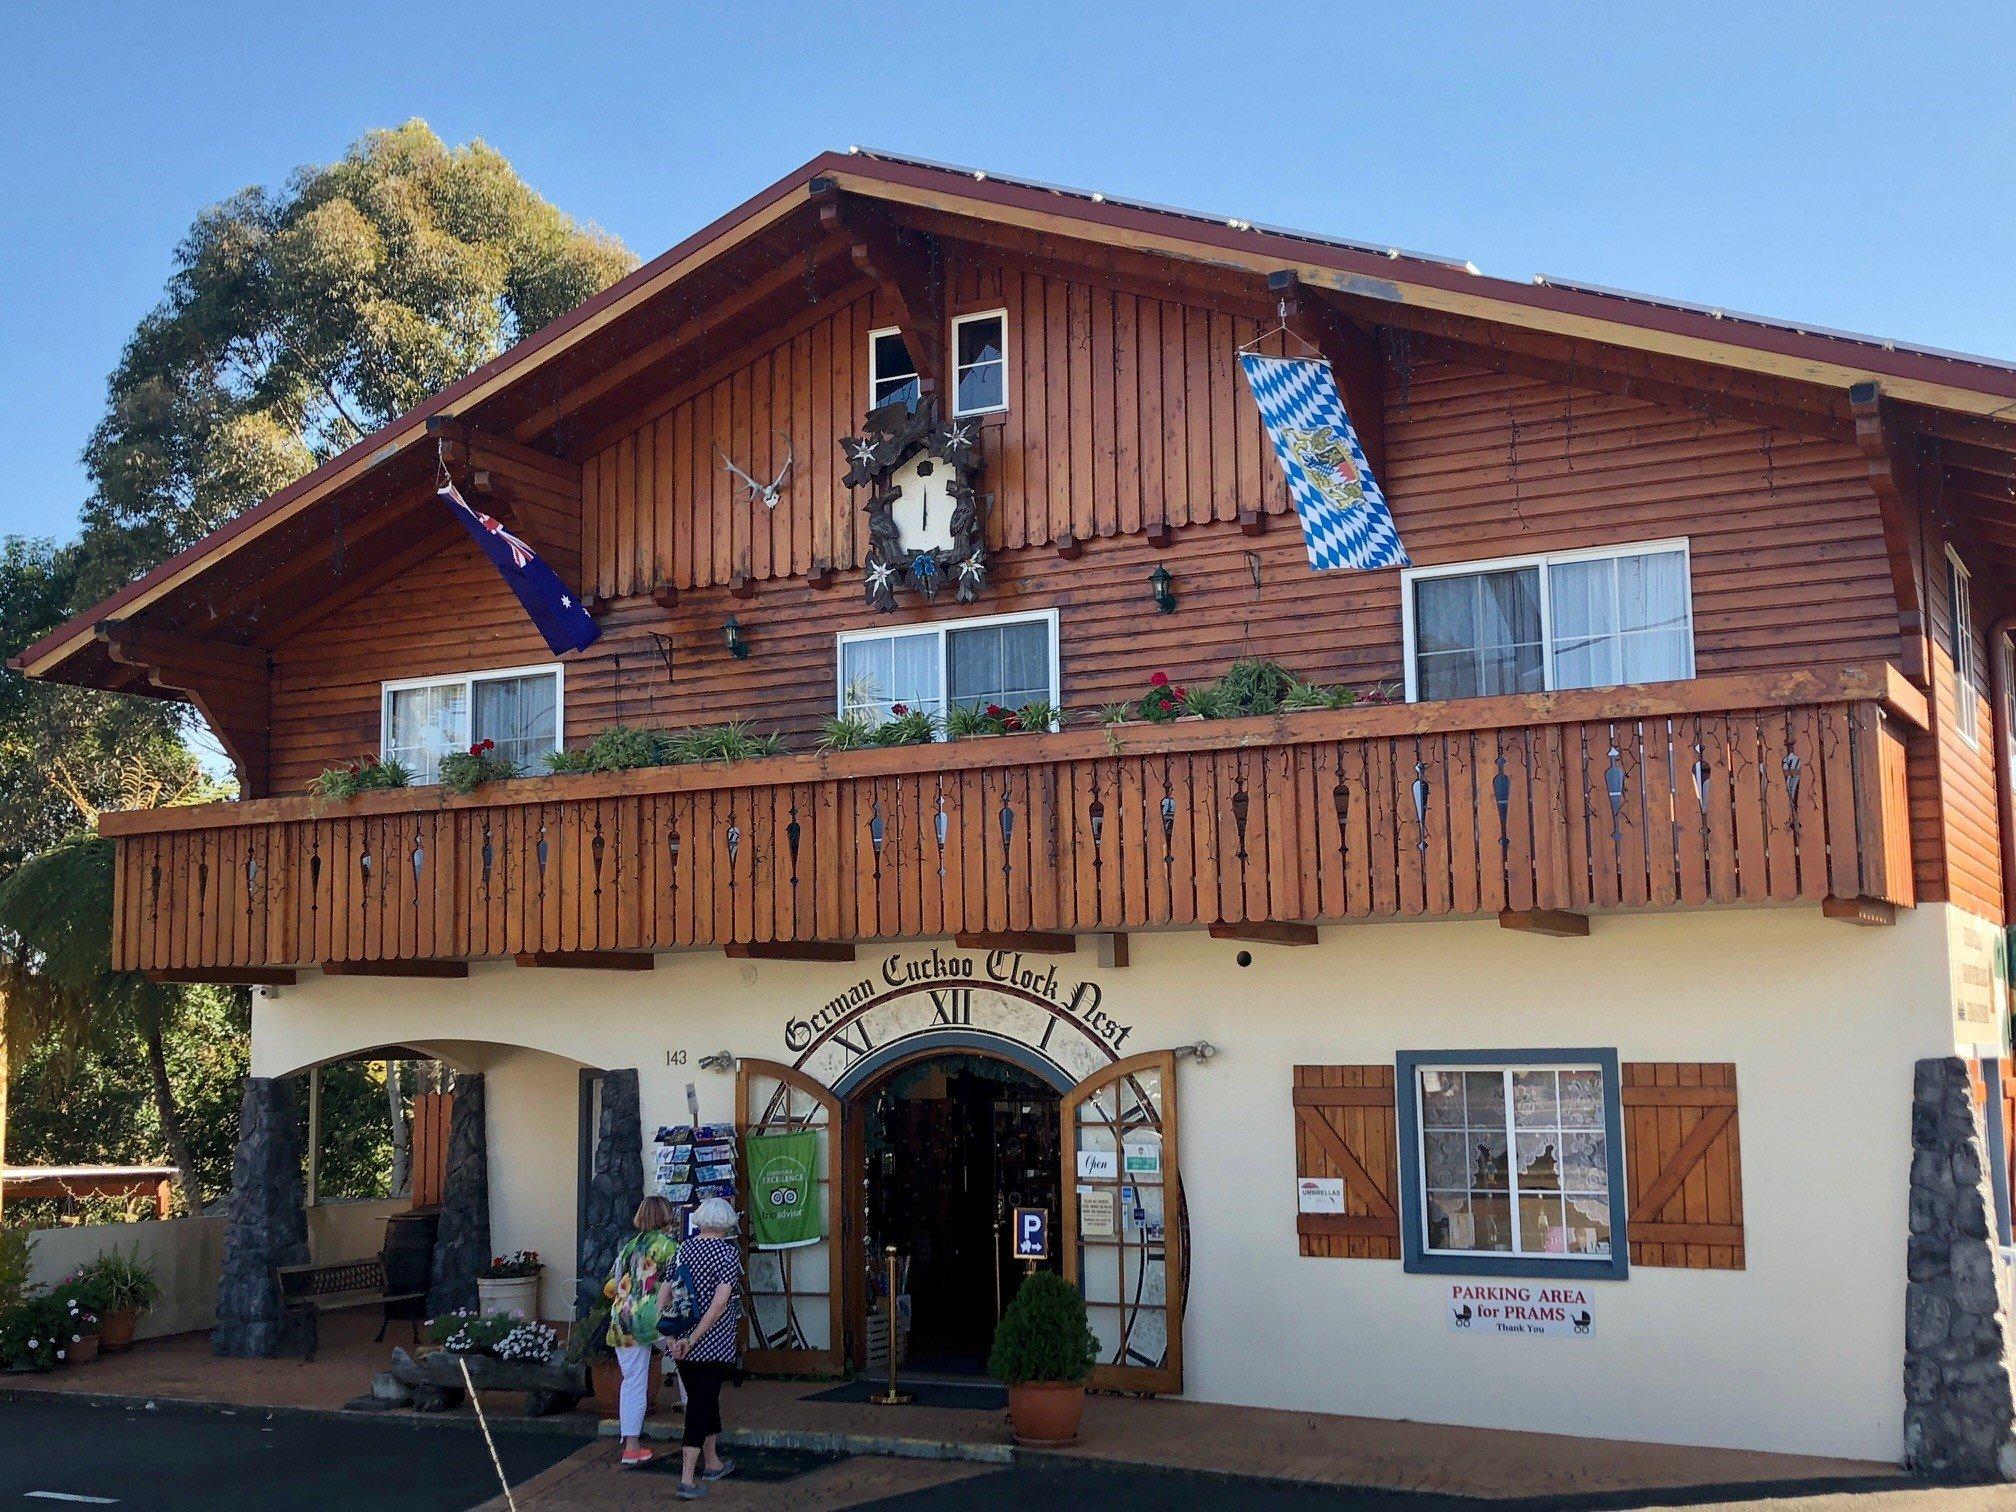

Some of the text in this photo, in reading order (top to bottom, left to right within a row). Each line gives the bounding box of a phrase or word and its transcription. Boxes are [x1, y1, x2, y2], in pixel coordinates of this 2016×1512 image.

[784, 947, 1133, 1052] German Cuckoo Clock Nest
[926, 988, 974, 1027] XII
[829, 1015, 878, 1071] XI
[1036, 1013, 1060, 1053] I
[666, 1050, 687, 1066] 143
[1085, 1153, 1107, 1175] Open
[1024, 1214, 1042, 1239] P
[1452, 1285, 1587, 1304] PARKING AREA
[1477, 1304, 1566, 1322] for PRAMS
[1496, 1323, 1545, 1334] Thank You
